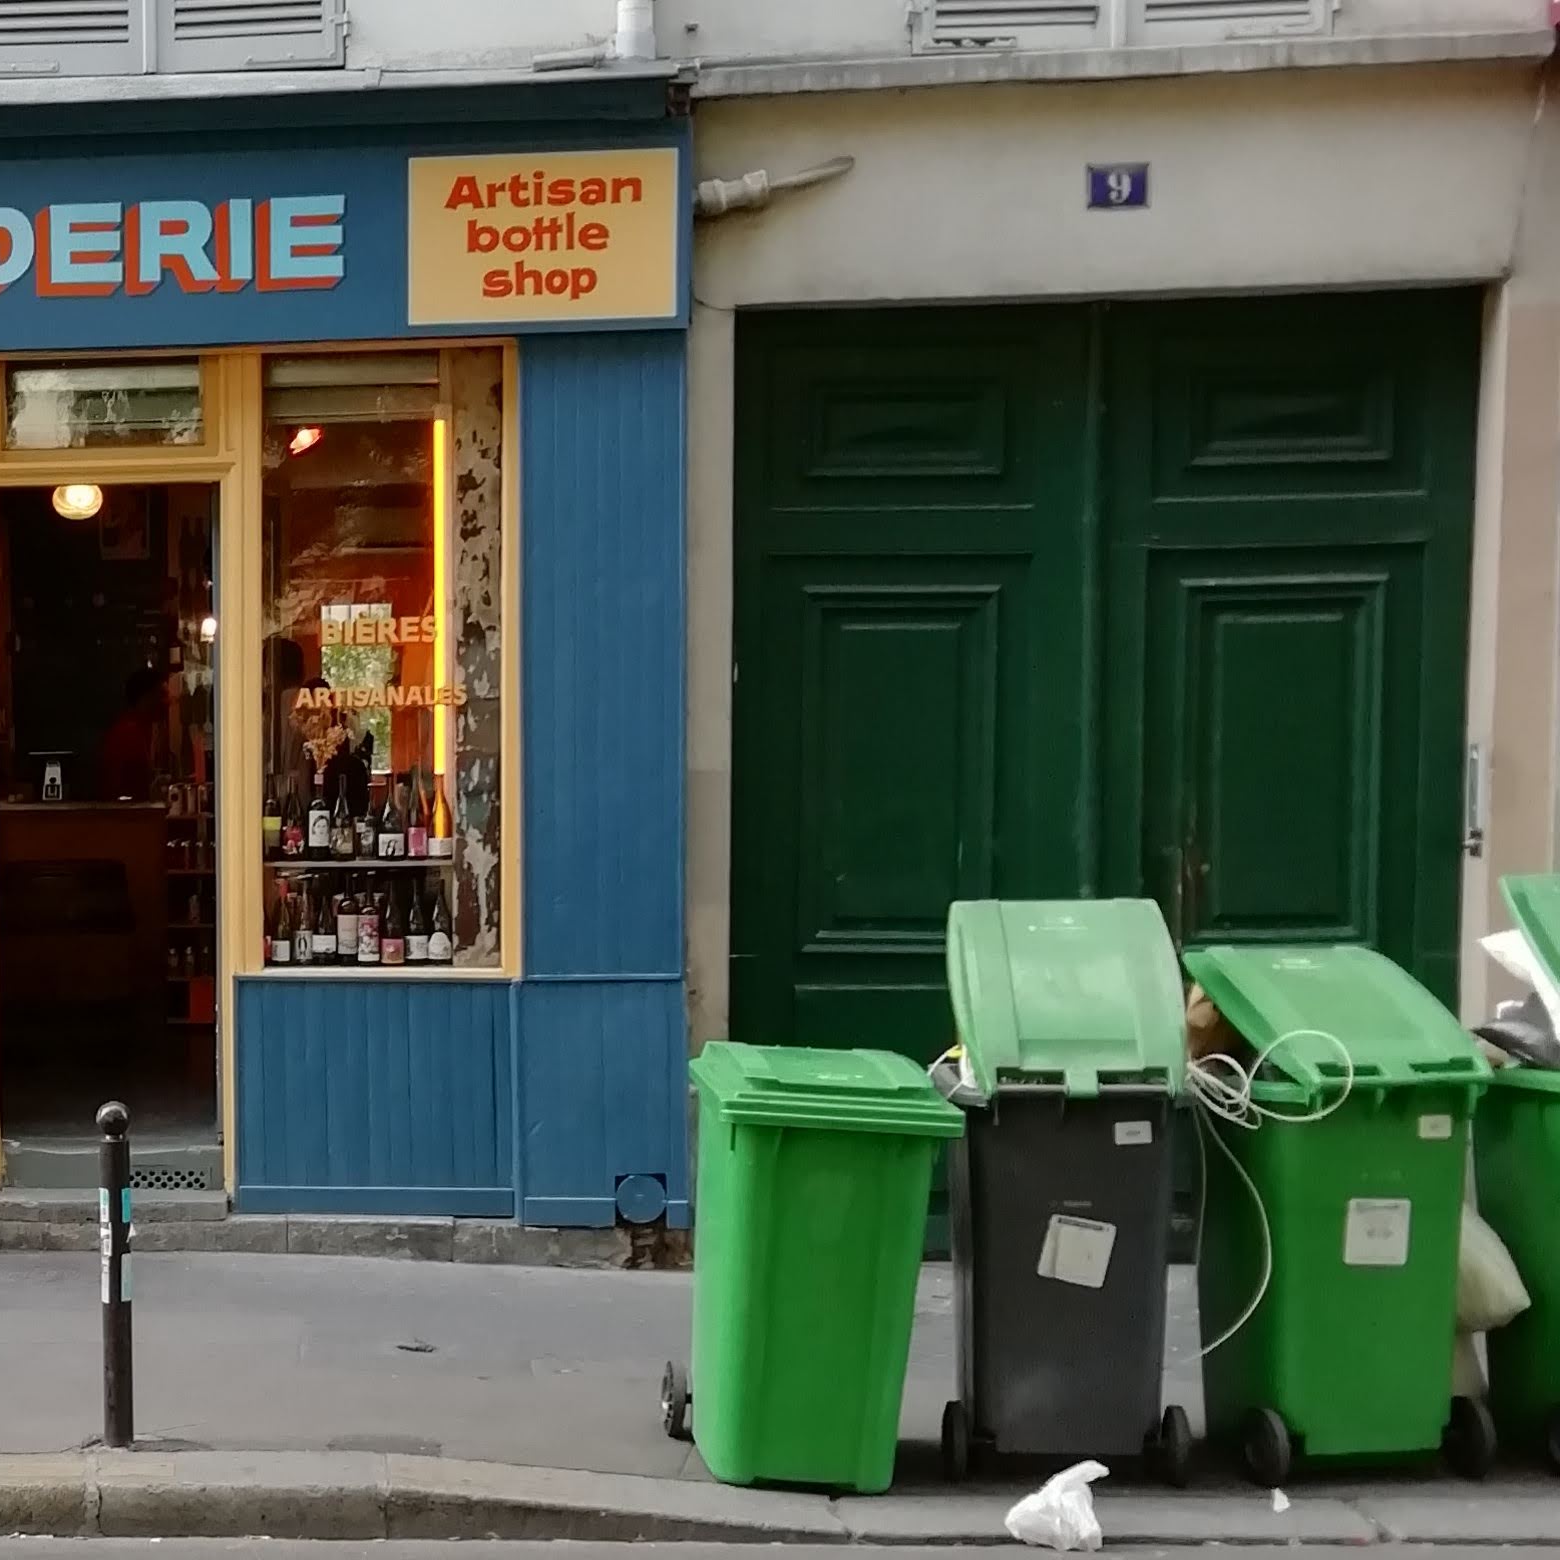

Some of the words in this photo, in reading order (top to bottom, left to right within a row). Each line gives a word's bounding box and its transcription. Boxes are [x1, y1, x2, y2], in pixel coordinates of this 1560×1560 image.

[444, 171, 642, 210] Artisan
[1108, 171, 1131, 203] 9
[467, 211, 609, 253] bottle
[482, 260, 598, 301] shop
[295, 684, 468, 709] ARTISANALES
